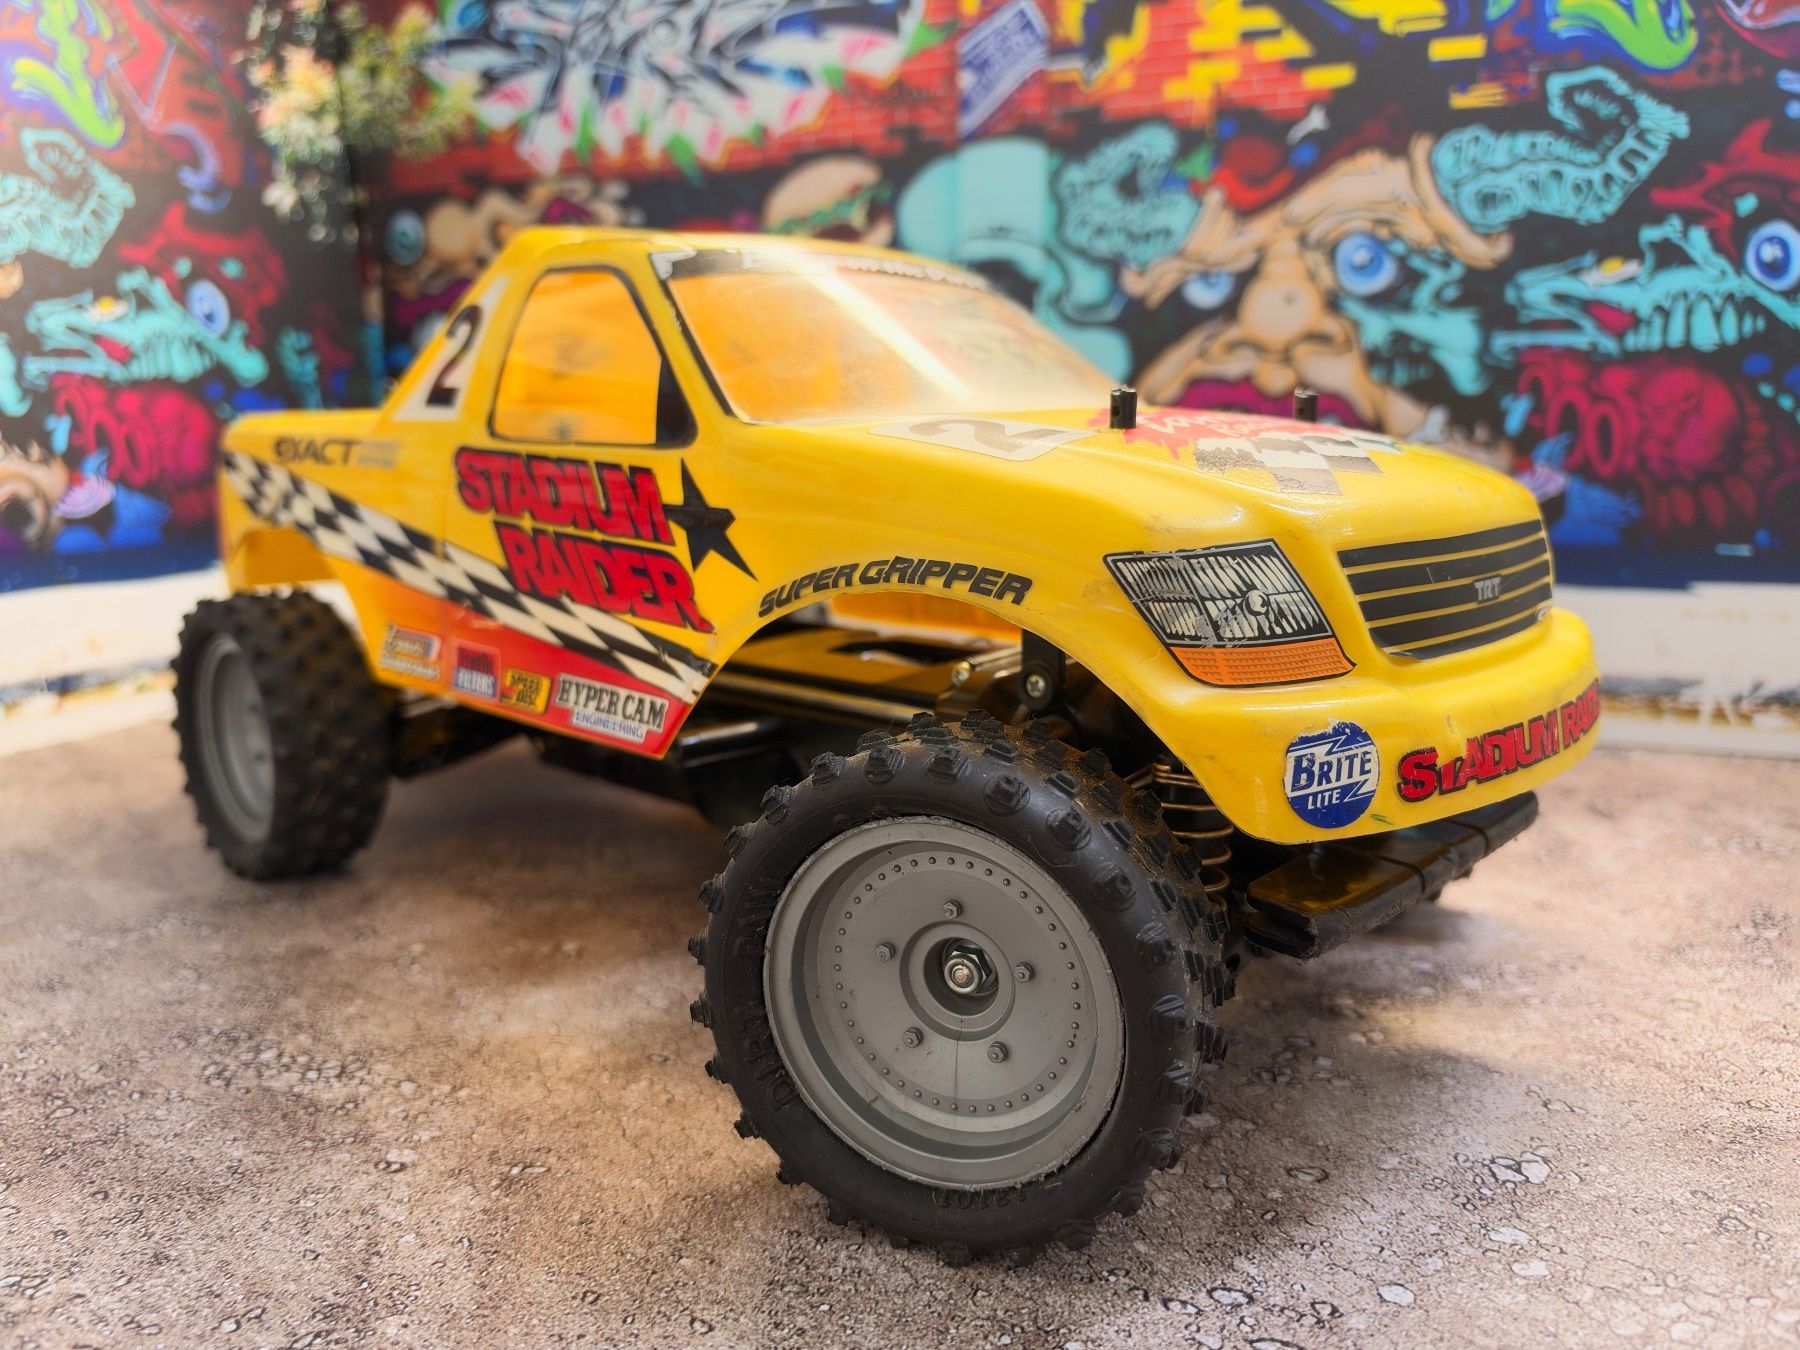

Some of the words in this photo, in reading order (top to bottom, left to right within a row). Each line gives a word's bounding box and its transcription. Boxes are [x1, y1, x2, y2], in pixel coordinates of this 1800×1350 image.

[426, 304, 481, 407] 2
[908, 419, 1068, 452] 2
[455, 447, 675, 545] STADIUM
[494, 519, 717, 634] RAIDER
[758, 563, 859, 618] SUPER
[859, 556, 1032, 605] GRIPPER
[1473, 577, 1500, 600] TRT
[558, 680, 621, 716] HYPER
[622, 694, 667, 730] CAM
[575, 711, 644, 738] ENGINEERING
[1291, 748, 1372, 792] BRITE
[1397, 709, 1559, 802] STADIUM
[1307, 788, 1341, 810] LITE
